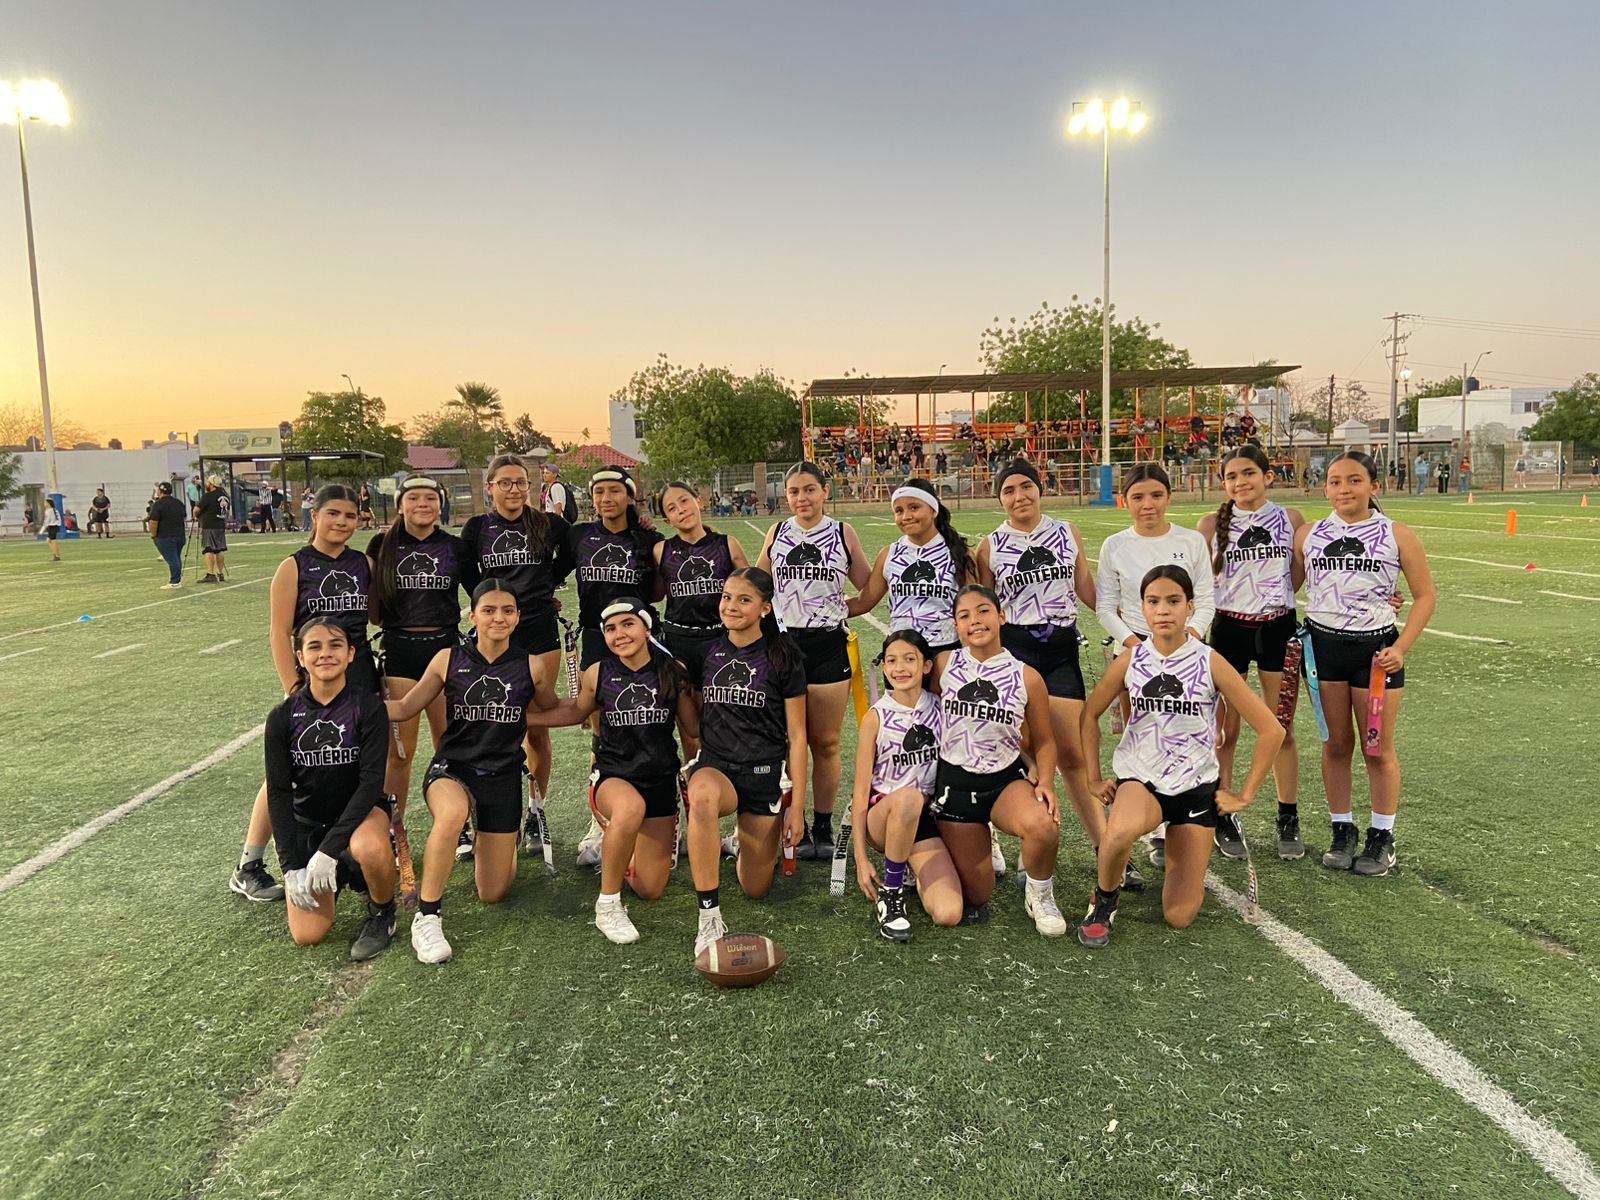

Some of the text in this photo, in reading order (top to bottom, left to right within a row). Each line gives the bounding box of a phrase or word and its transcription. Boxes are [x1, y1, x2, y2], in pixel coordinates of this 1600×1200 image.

[1226, 546, 1287, 563] PANTERAS
[776, 566, 835, 582] PANTERAS
[1311, 558, 1381, 572] PANTERAS
[396, 575, 450, 589] ANTERAS
[580, 566, 641, 584] PANTERAS
[1005, 566, 1073, 591] PANTERAS
[670, 579, 724, 597] PANTERAS
[891, 583, 950, 599] PANTERAS
[703, 686, 766, 708] PANTERAS
[454, 704, 521, 723] PANTERAS
[944, 699, 1014, 725] PANTERAS
[1131, 697, 1200, 716] PANTERAS
[606, 708, 669, 726] PANTERAS
[892, 747, 941, 767] PANTER
[834, 824, 852, 860] SONORA
[726, 944, 757, 953] Wilson
